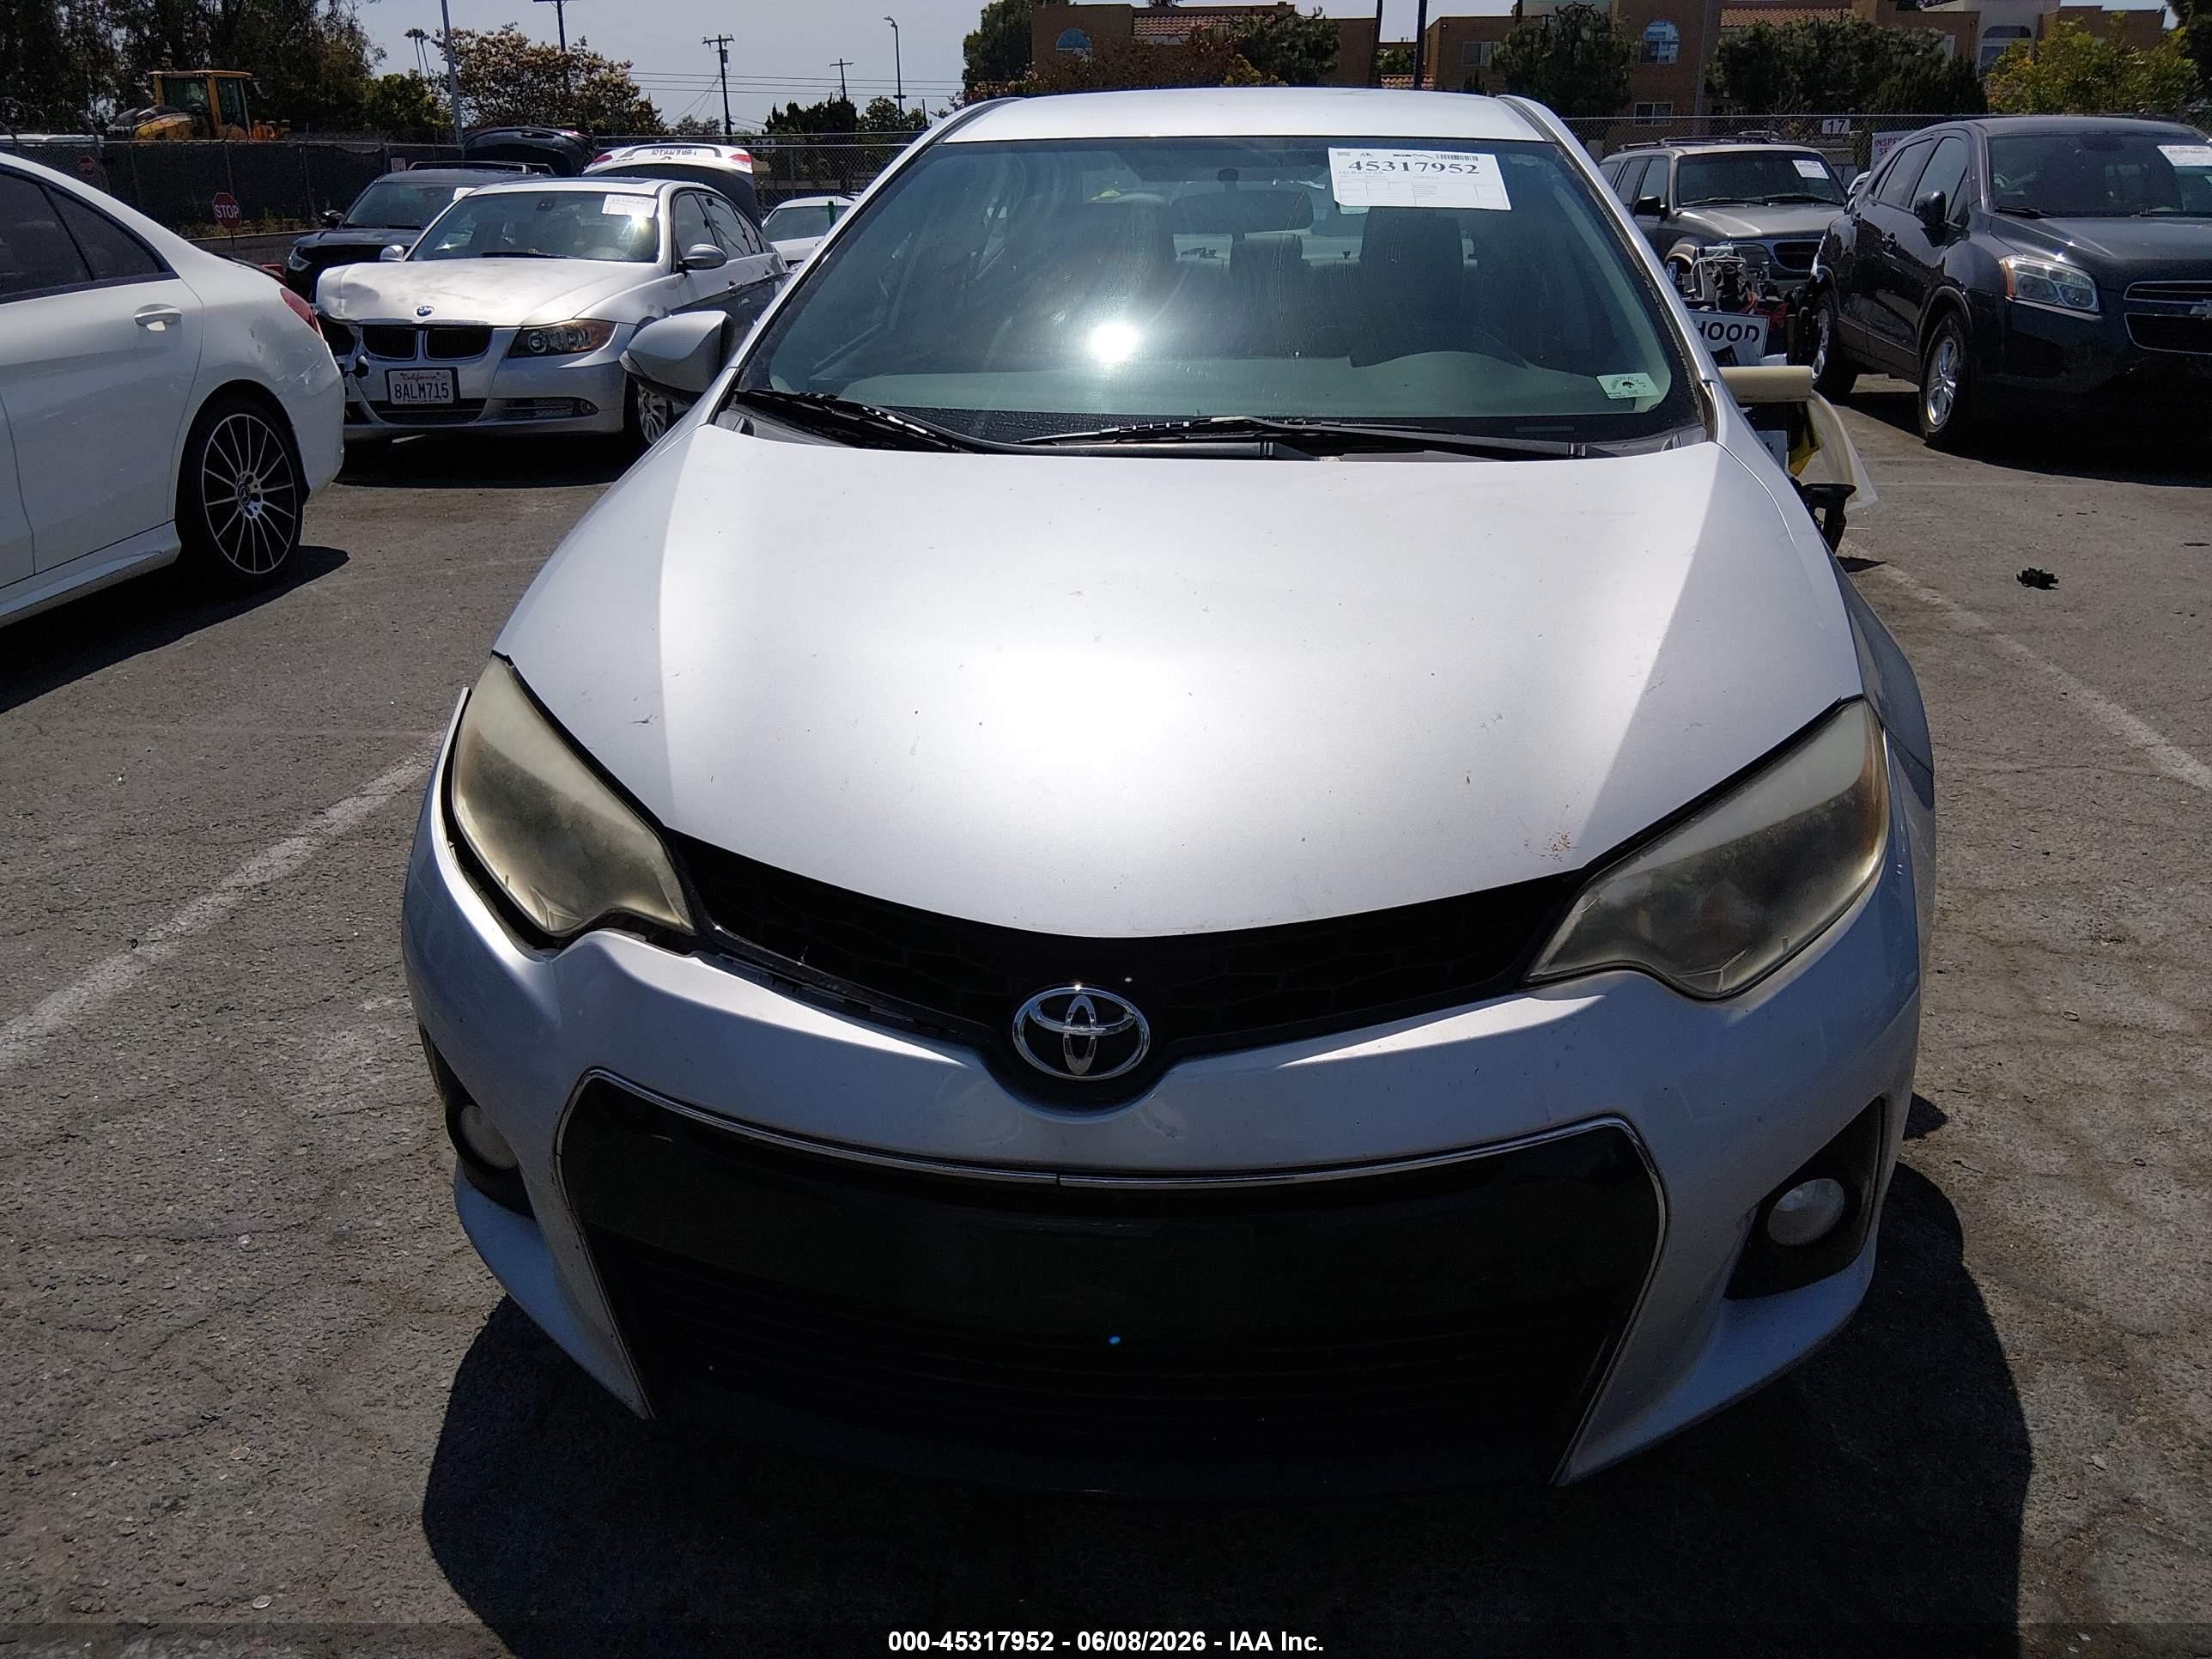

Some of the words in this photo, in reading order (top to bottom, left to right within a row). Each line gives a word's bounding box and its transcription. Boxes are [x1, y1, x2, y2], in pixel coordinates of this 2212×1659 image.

[1828, 120, 1846, 133] 17
[1348, 161, 1480, 174] 45317952
[215, 205, 239, 218] STOP
[394, 383, 449, 399] 8ALM715
